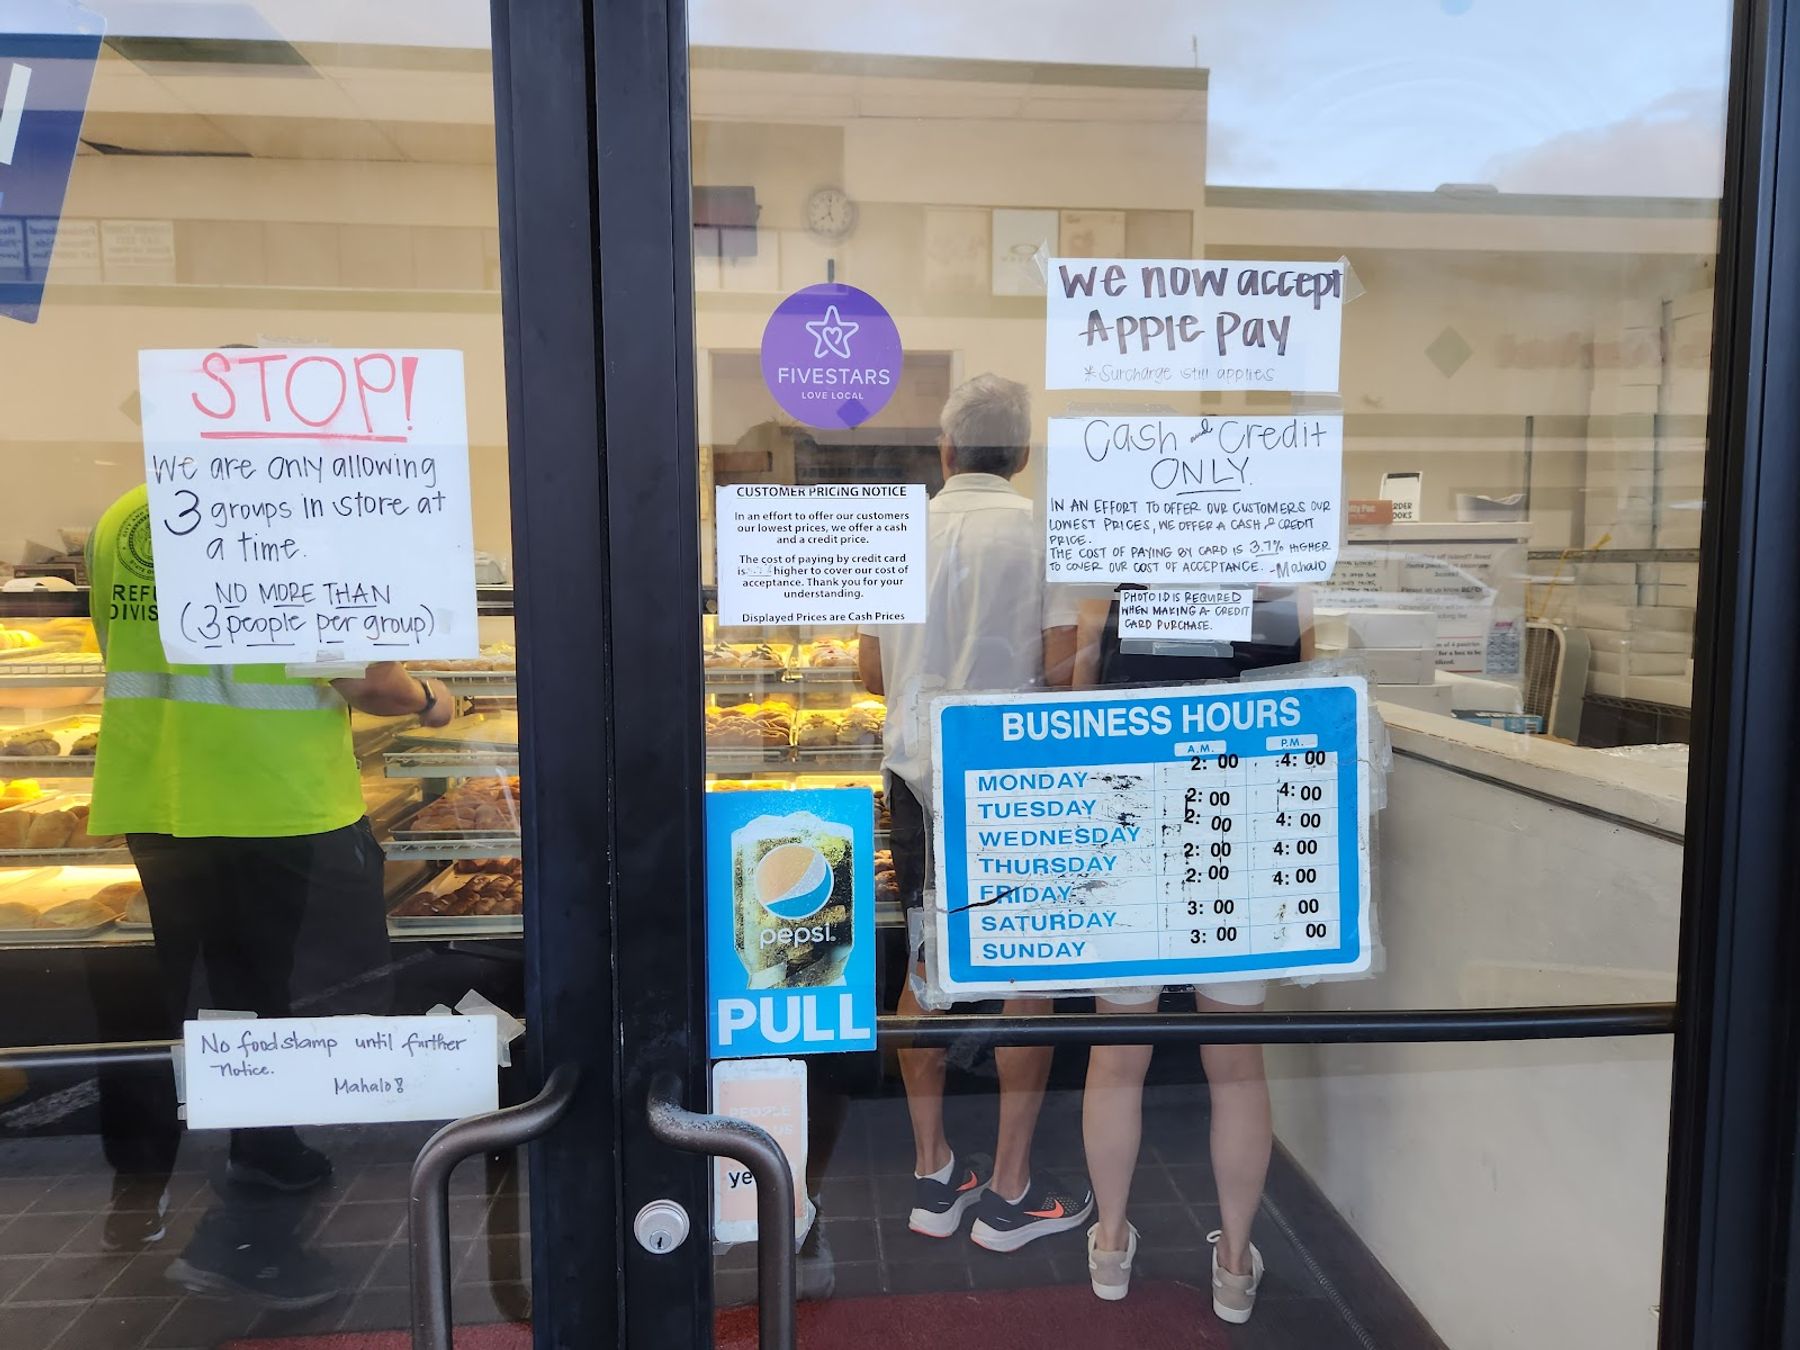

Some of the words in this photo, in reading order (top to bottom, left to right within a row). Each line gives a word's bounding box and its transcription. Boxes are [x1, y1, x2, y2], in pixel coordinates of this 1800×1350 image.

[1058, 264, 1128, 299] We
[1141, 266, 1229, 299] now
[1237, 269, 1344, 311] accept
[1078, 309, 1205, 355] Apple
[1216, 311, 1291, 357] Pay
[777, 366, 891, 386] FIVESTARS
[1180, 367, 1209, 381] still
[1217, 365, 1275, 382] applies
[191, 352, 419, 434] STOP!
[801, 391, 829, 401] LOVE
[831, 391, 864, 401] LOCAL
[1084, 419, 1177, 462] Cash
[1218, 418, 1327, 454] Credit
[152, 454, 199, 485] We
[210, 456, 258, 480] are
[267, 455, 324, 484] only
[332, 454, 437, 488] allowing
[1150, 456, 1253, 489] ONLY.
[736, 486, 806, 497] CUSTOMER
[808, 486, 859, 497] PRICING
[862, 486, 907, 497] NOTICE
[164, 489, 202, 536] 3
[210, 498, 292, 529] groups
[302, 493, 324, 518] in
[332, 491, 409, 518] store
[418, 491, 447, 514] at
[734, 512, 745, 521] In
[747, 513, 760, 521] an
[762, 511, 792, 521] effort
[795, 512, 805, 521] to
[808, 511, 834, 521] offer
[1050, 497, 1064, 512] IN
[1070, 499, 1089, 512] AN
[1094, 499, 1138, 515] EFFORT
[1146, 501, 1160, 514] TO
[1164, 501, 1201, 515] OFFER
[1207, 501, 1228, 515] OUR
[1232, 501, 1306, 515] CUSTOMERS
[1310, 500, 1331, 512] OUR
[758, 524, 792, 532] lowest
[795, 524, 828, 535] prices,
[849, 523, 874, 532] offer
[884, 523, 907, 532] cash
[1049, 518, 1096, 531] LOWEST
[1104, 517, 1157, 534] PRICES,
[1158, 520, 1175, 530] WE
[1178, 518, 1213, 531] OFFER
[1216, 519, 1226, 531] A
[1230, 517, 1261, 531] CASH
[1278, 517, 1314, 529] CREDIT
[206, 536, 225, 560] a
[236, 532, 307, 562] time.
[776, 535, 797, 544] and
[799, 536, 805, 544] a
[807, 535, 838, 544] credit
[840, 535, 869, 546] price.
[1049, 534, 1093, 546] PRICE.
[1050, 546, 1072, 560] THE
[1078, 546, 1106, 559] COST
[1112, 545, 1125, 557] OF
[1131, 545, 1173, 558] PAYING
[1178, 546, 1193, 558] BY
[1198, 545, 1228, 556] CARD
[1233, 543, 1243, 555] IS
[1249, 539, 1284, 553] 3.7%
[1289, 540, 1330, 552] HIGHER
[739, 555, 759, 564] The
[761, 555, 782, 564] cost
[785, 554, 796, 564] of
[798, 555, 834, 566] paying
[836, 554, 849, 566] by
[852, 554, 882, 563] credit
[884, 554, 906, 563] card
[1049, 561, 1061, 572] TO
[1066, 560, 1103, 571] COVER
[1109, 560, 1128, 573] OUR
[1133, 560, 1159, 573] COST
[1165, 560, 1178, 571] OF
[1182, 560, 1264, 573] ACCEPTANCE.
[773, 566, 808, 577] higher
[811, 566, 822, 575] to
[875, 566, 896, 574] cost
[898, 565, 909, 574] of
[113, 584, 156, 601] REF
[214, 581, 248, 604] NO
[259, 581, 316, 604] MORE
[322, 582, 392, 605] THAN
[742, 579, 804, 589] acceptance.
[807, 578, 839, 587] Thank
[841, 579, 861, 589] you
[863, 577, 878, 586] for
[880, 578, 904, 589] your
[784, 589, 864, 599] understanding.
[1124, 591, 1156, 602] PHOTO
[1172, 592, 1180, 602] IS
[1185, 591, 1241, 603] REQUIRED
[742, 613, 794, 623] Displayed
[797, 613, 827, 622] Prices
[848, 613, 873, 621] Cash
[875, 612, 905, 621] Prices
[1121, 606, 1148, 616] WHEN
[1153, 606, 1196, 616] MAKING
[1199, 606, 1210, 615] A
[1215, 606, 1250, 616] CREDIT
[227, 610, 307, 644] people
[317, 614, 357, 643] per
[1125, 619, 1152, 629] CARD
[1157, 620, 1213, 630] PURCHASE.
[1002, 706, 1172, 742] BUSINESS
[1182, 697, 1301, 734] HOURS
[1186, 743, 1215, 755] A.M.
[1280, 737, 1304, 748] P.M.
[978, 771, 1089, 793] MONDAY
[977, 799, 1097, 820] TUESDAY
[979, 826, 1142, 848] WEDNESDAY
[979, 855, 1118, 875] THURSDAY
[980, 884, 1073, 904] FRIDAY
[981, 912, 1118, 933] SATURDAY
[759, 923, 832, 949] pepsi
[982, 941, 1087, 961] SUNDAY
[718, 993, 871, 1046] PULL
[201, 1034, 231, 1054] No
[354, 1032, 393, 1052] until
[401, 1032, 467, 1058] further
[333, 1077, 404, 1096] Mahalo!
